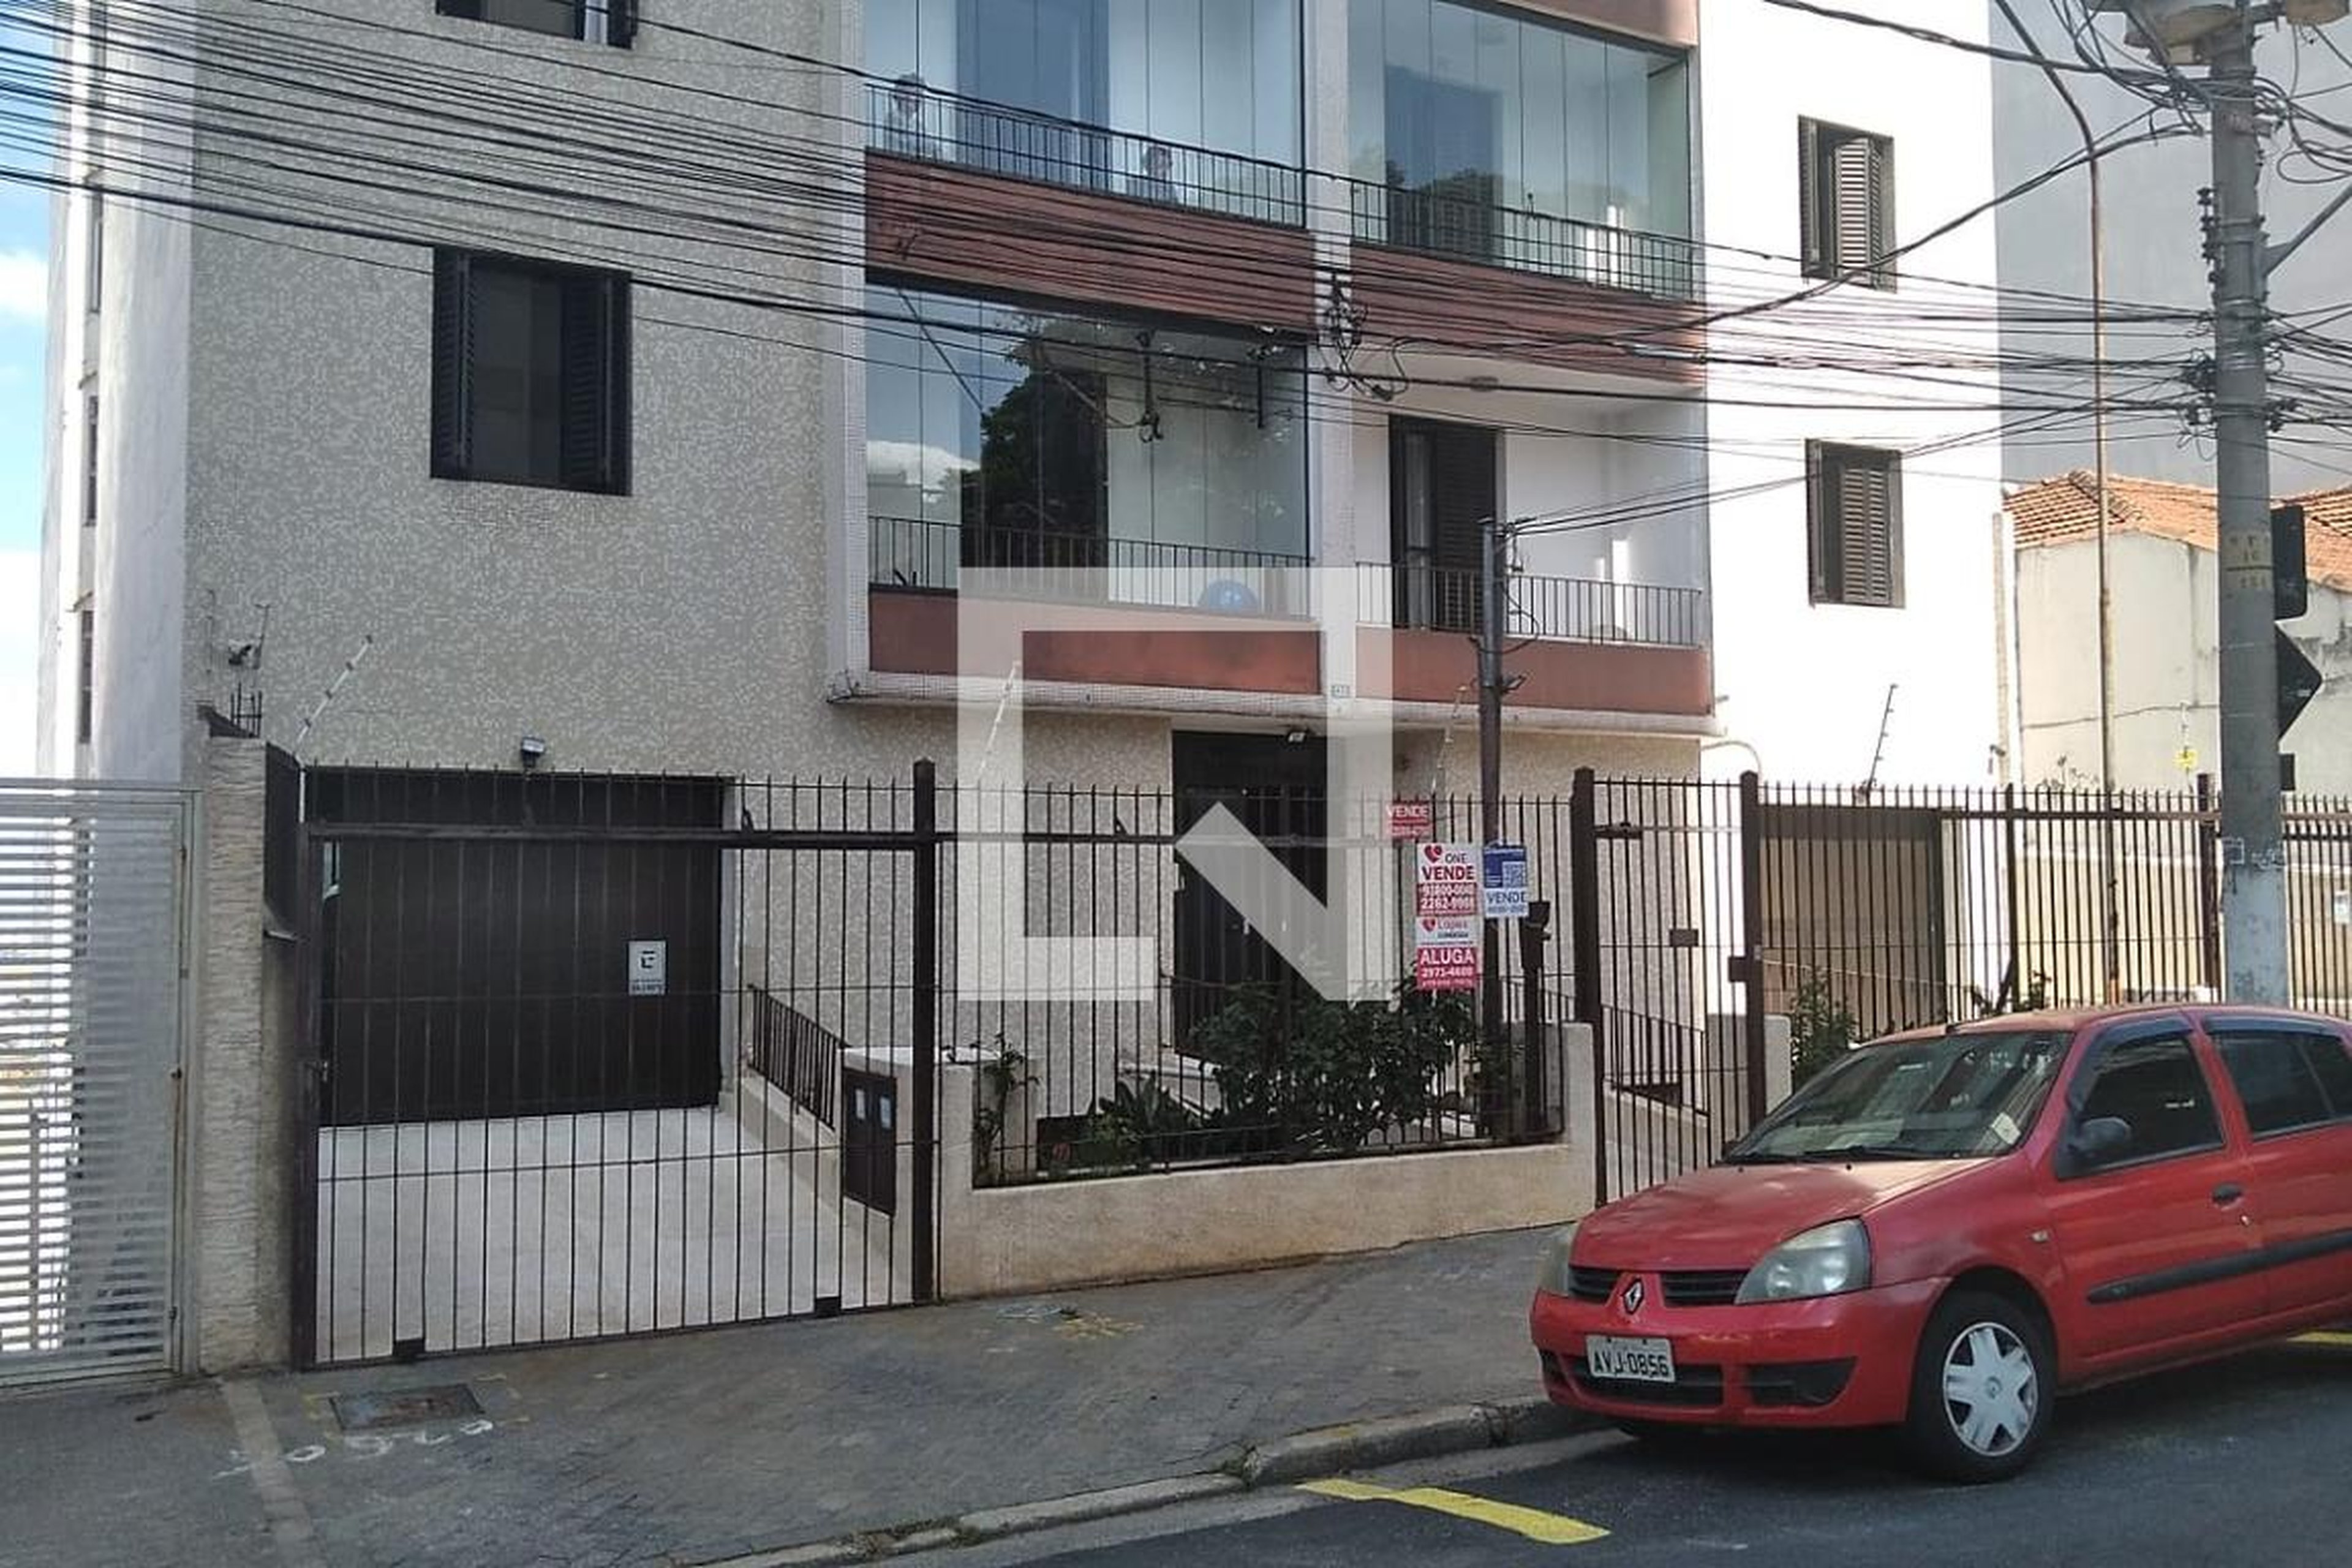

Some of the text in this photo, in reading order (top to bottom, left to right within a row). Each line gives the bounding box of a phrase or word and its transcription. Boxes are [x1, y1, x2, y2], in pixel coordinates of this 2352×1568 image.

[1385, 804, 1429, 818] VENDE
[1445, 853, 1467, 864] ONE
[1422, 865, 1474, 881] VENDE
[1486, 891, 1526, 905] VENDE
[1420, 948, 1475, 964] ALUGA
